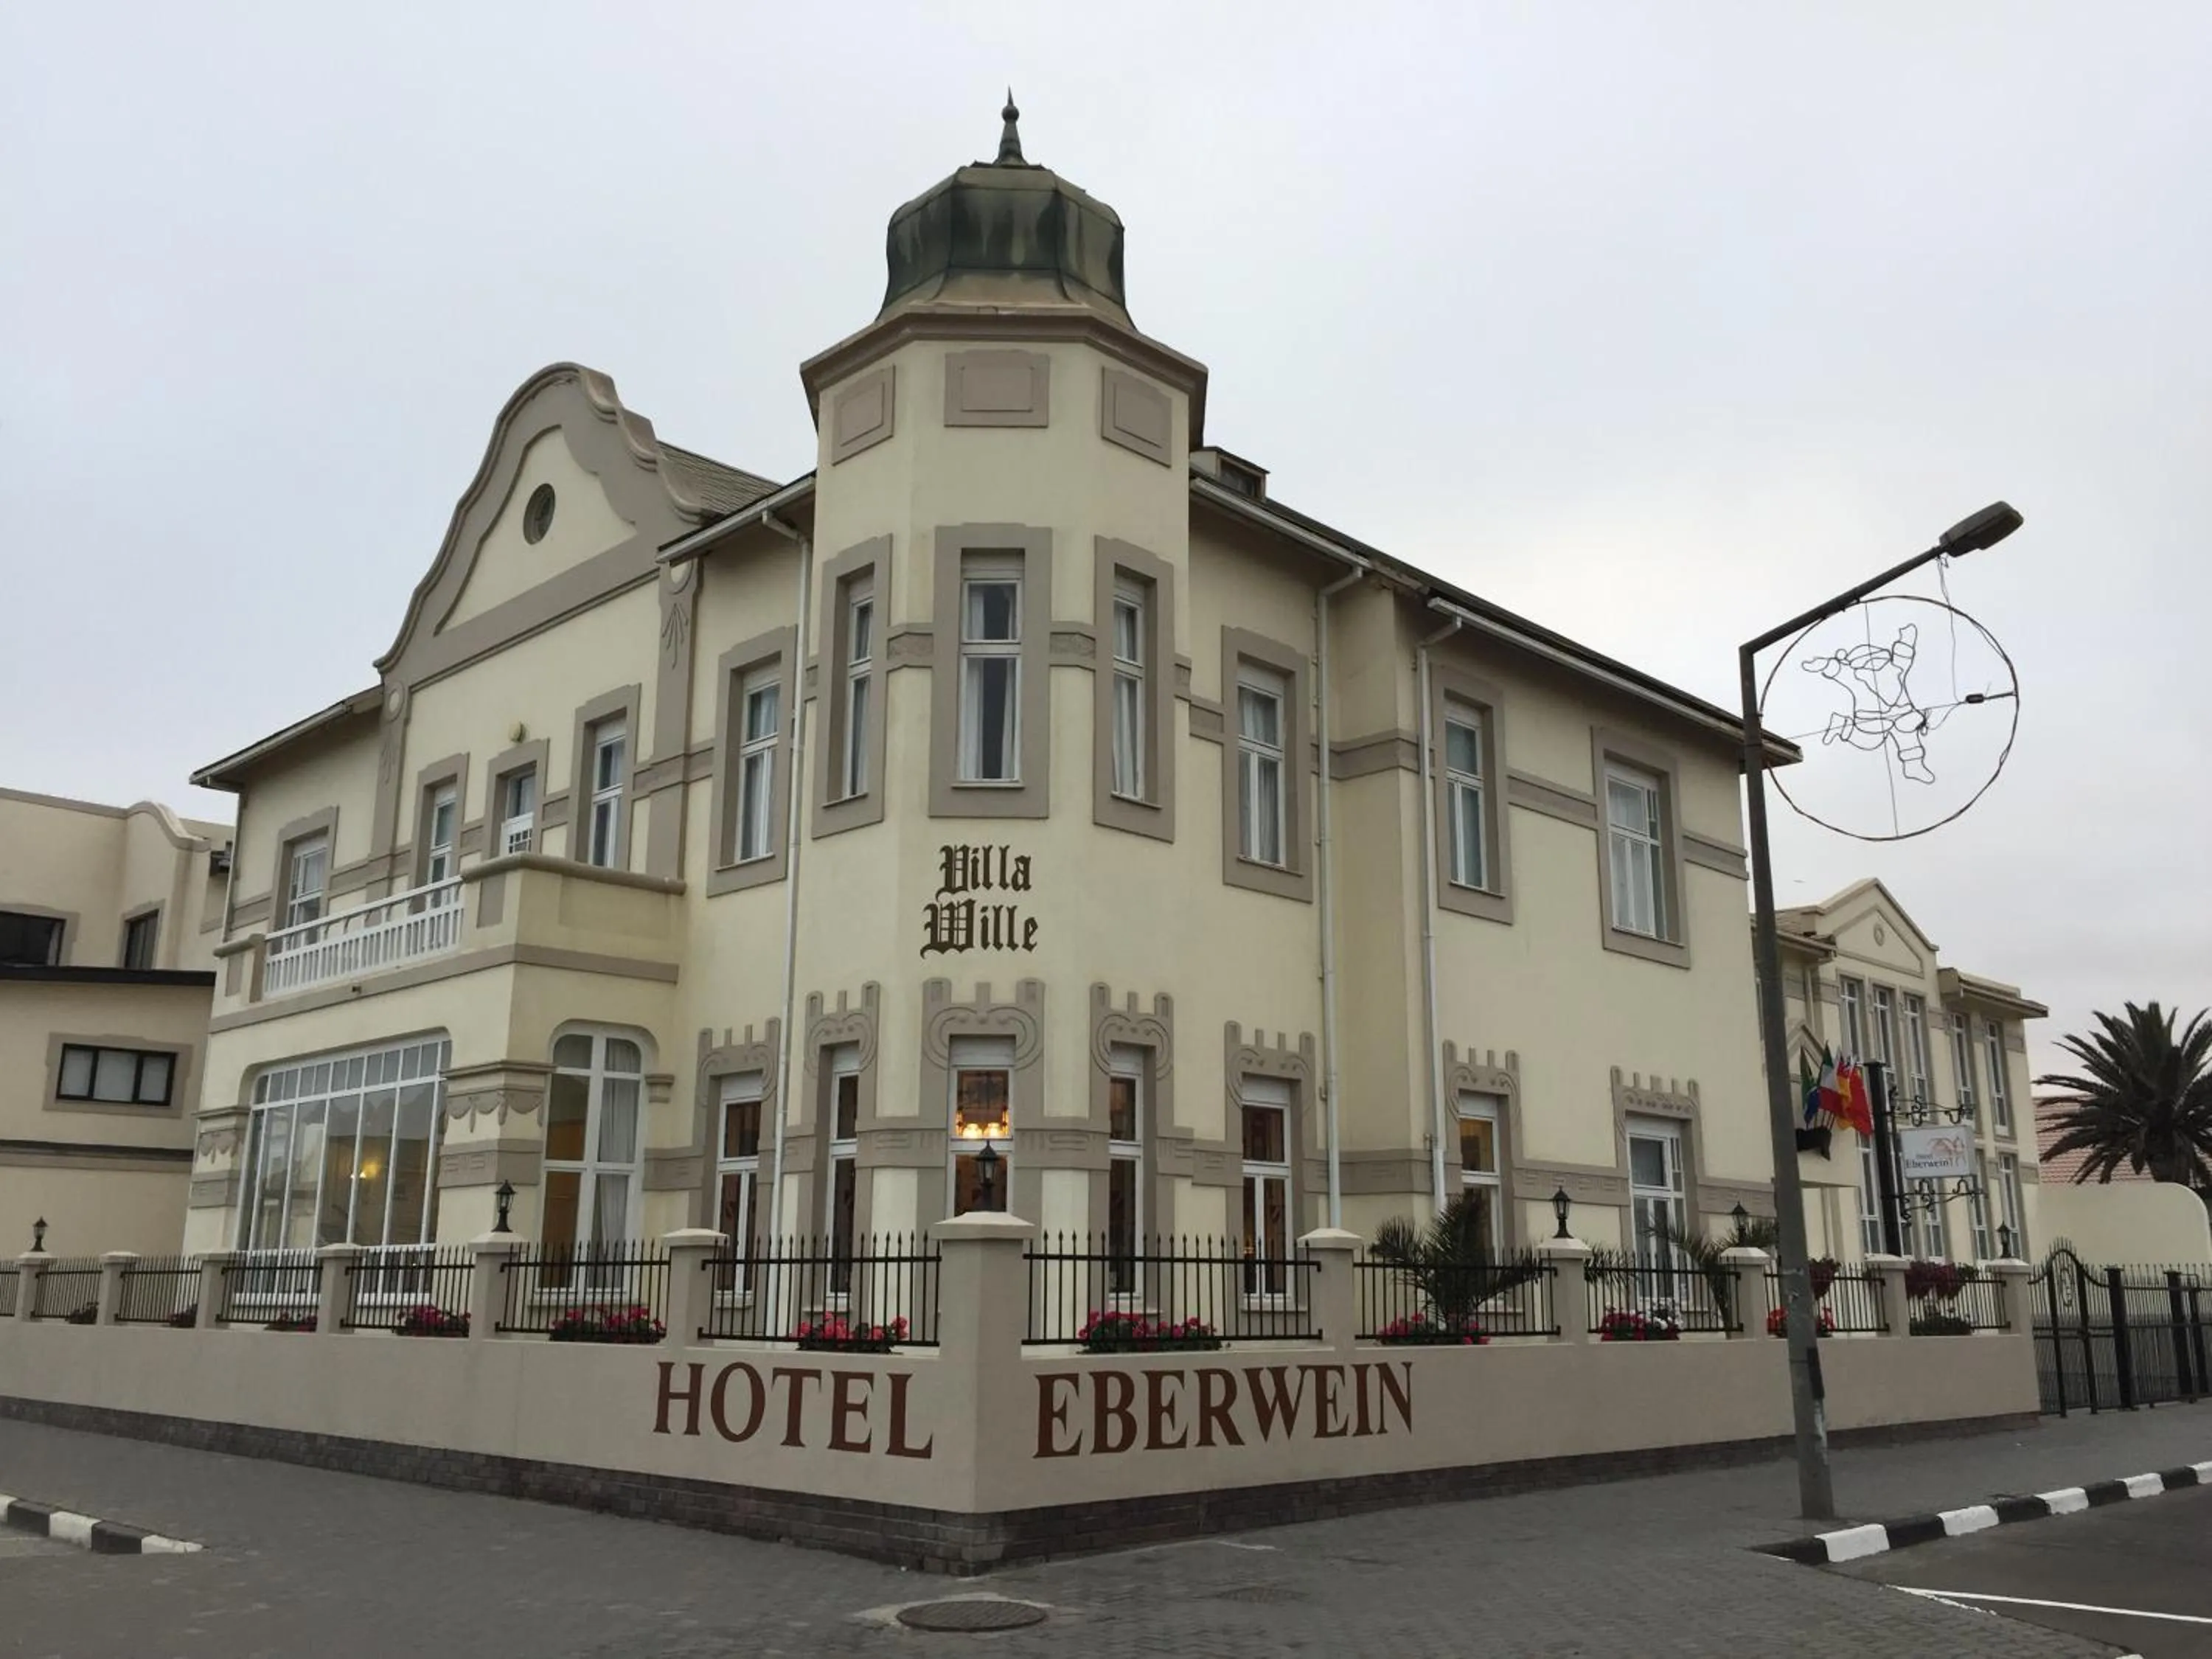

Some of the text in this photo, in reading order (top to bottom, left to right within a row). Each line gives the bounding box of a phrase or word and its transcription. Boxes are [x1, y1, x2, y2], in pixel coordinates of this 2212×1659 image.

[936, 844, 1032, 900] Villa
[920, 898, 1039, 959] Wille
[653, 1361, 1413, 1459] HOTEL EBERWEIN
